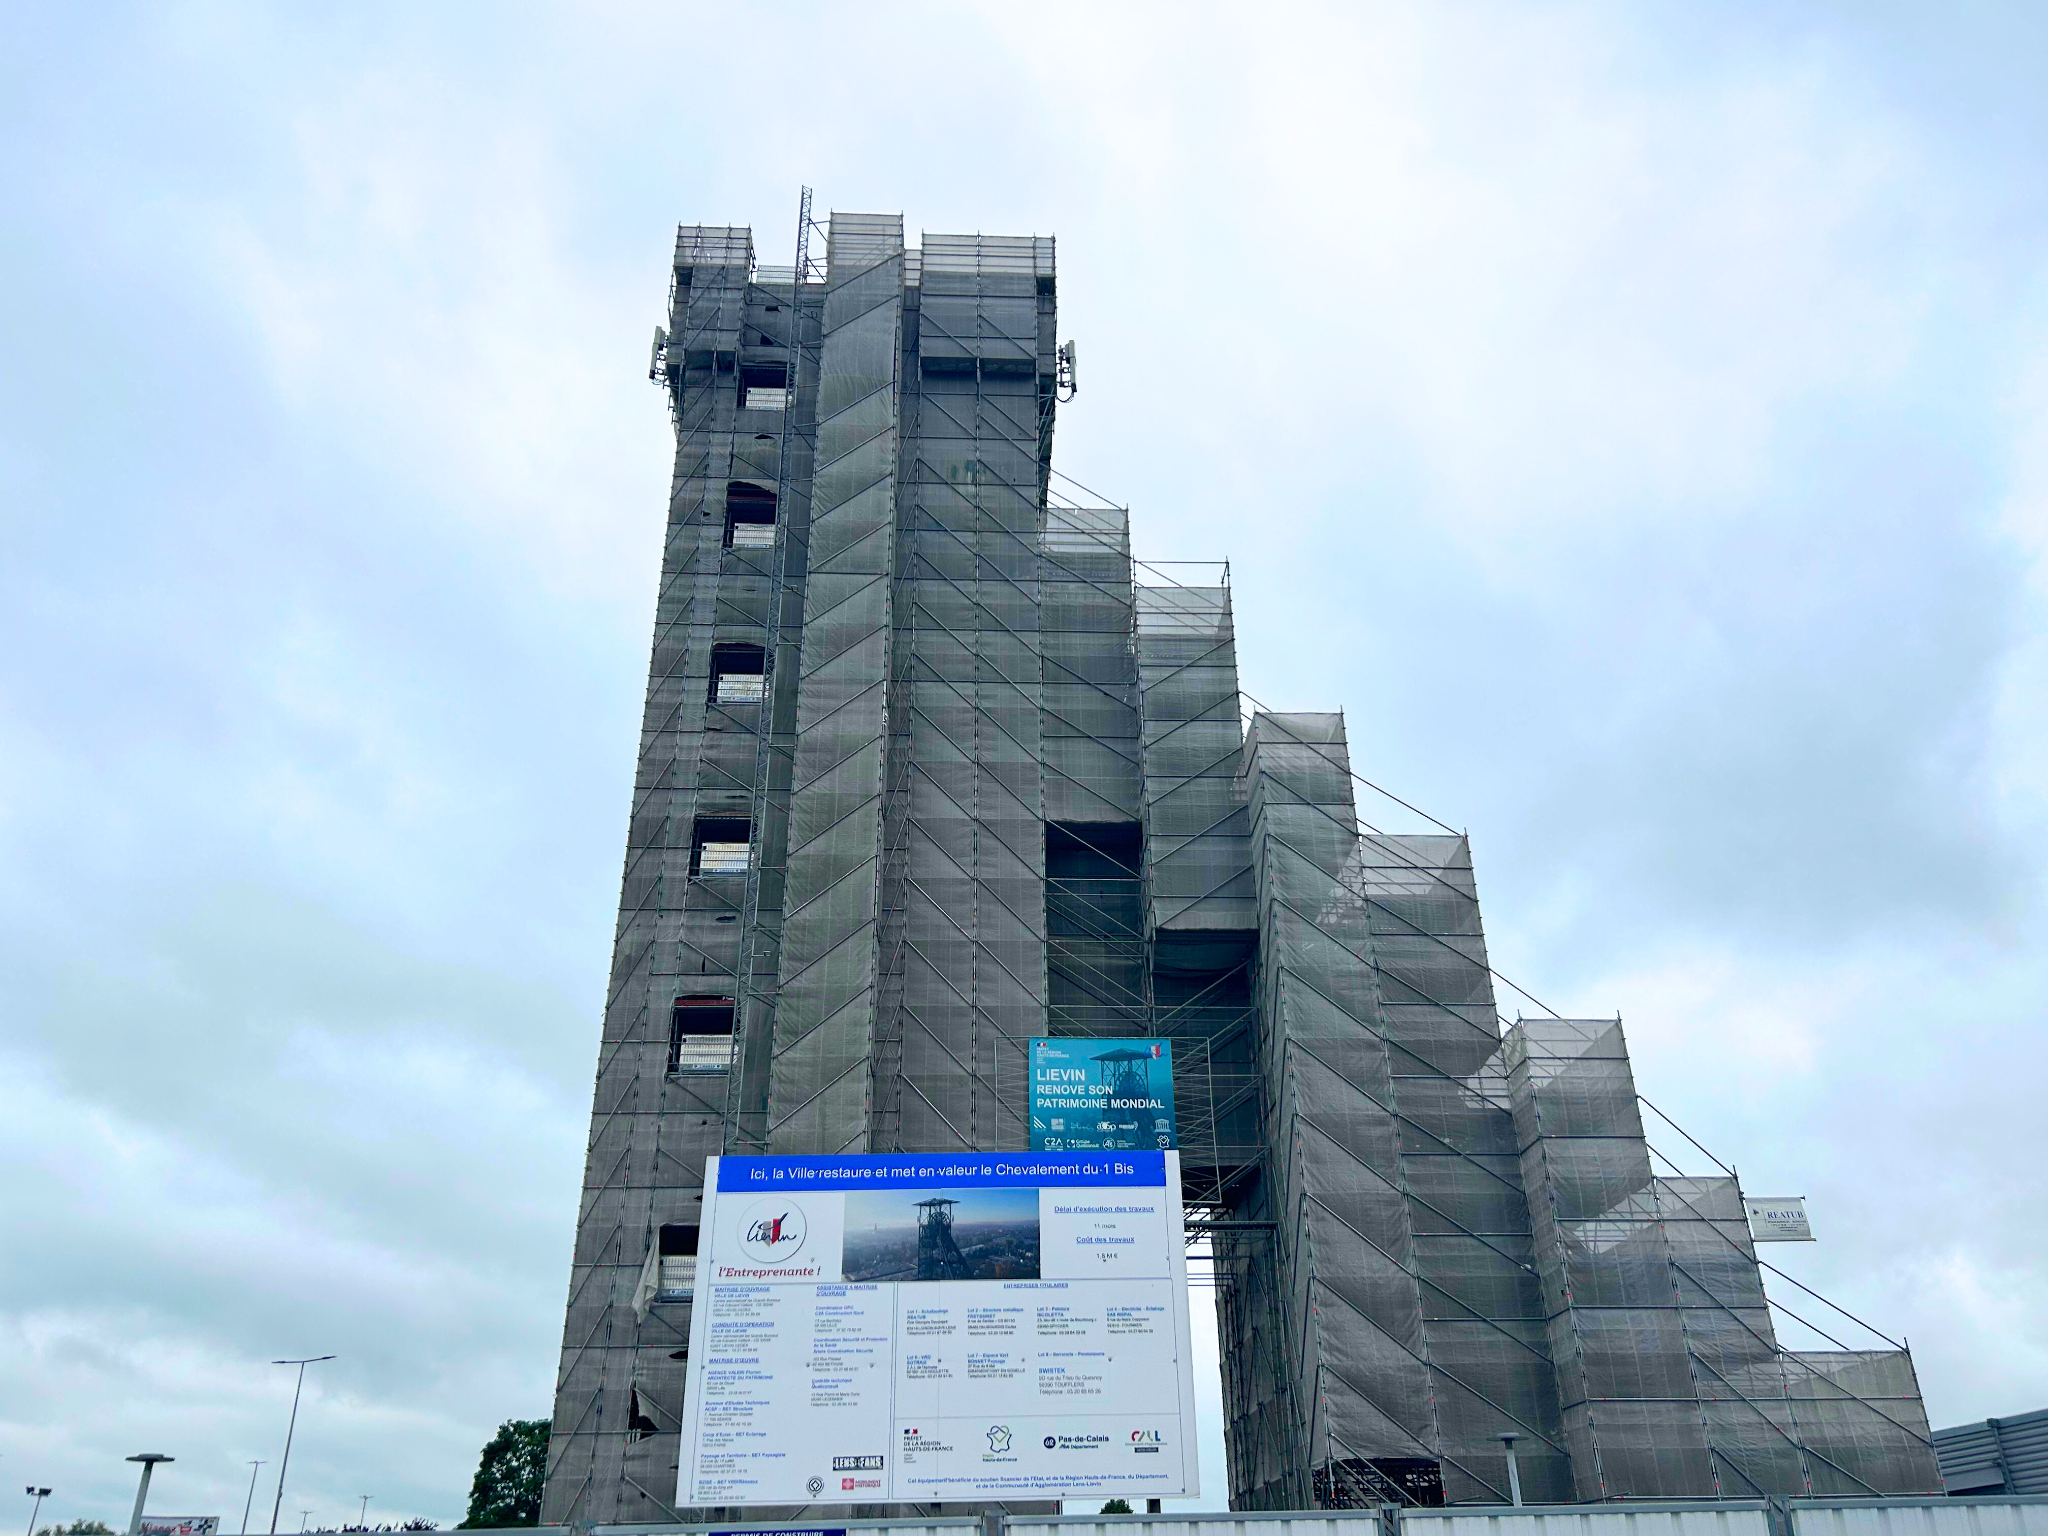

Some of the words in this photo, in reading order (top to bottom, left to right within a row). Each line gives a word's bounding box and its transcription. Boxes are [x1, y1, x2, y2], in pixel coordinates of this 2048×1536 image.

[1037, 1069, 1085, 1080] LIEVIN
[1037, 1085, 1085, 1094] RENOVE
[1089, 1085, 1113, 1094] SON
[1037, 1099, 1107, 1108] PATRIMOINE
[1111, 1099, 1164, 1108] MONDIAL
[751, 1168, 768, 1180] Ici,
[773, 1168, 784, 1179] la
[788, 1167, 815, 1178] Ville
[819, 1167, 872, 1178] restaure
[876, 1167, 887, 1177] et
[892, 1167, 915, 1177] met
[919, 1168, 934, 1176] en
[939, 1165, 977, 1176] valeur
[981, 1164, 991, 1175] le
[996, 1164, 1079, 1175] Chevalement
[1083, 1164, 1098, 1174] du
[1103, 1164, 1109, 1174] 1
[1114, 1163, 1134, 1174] Bis
[719, 1266, 814, 1279] l'Entreprenante
